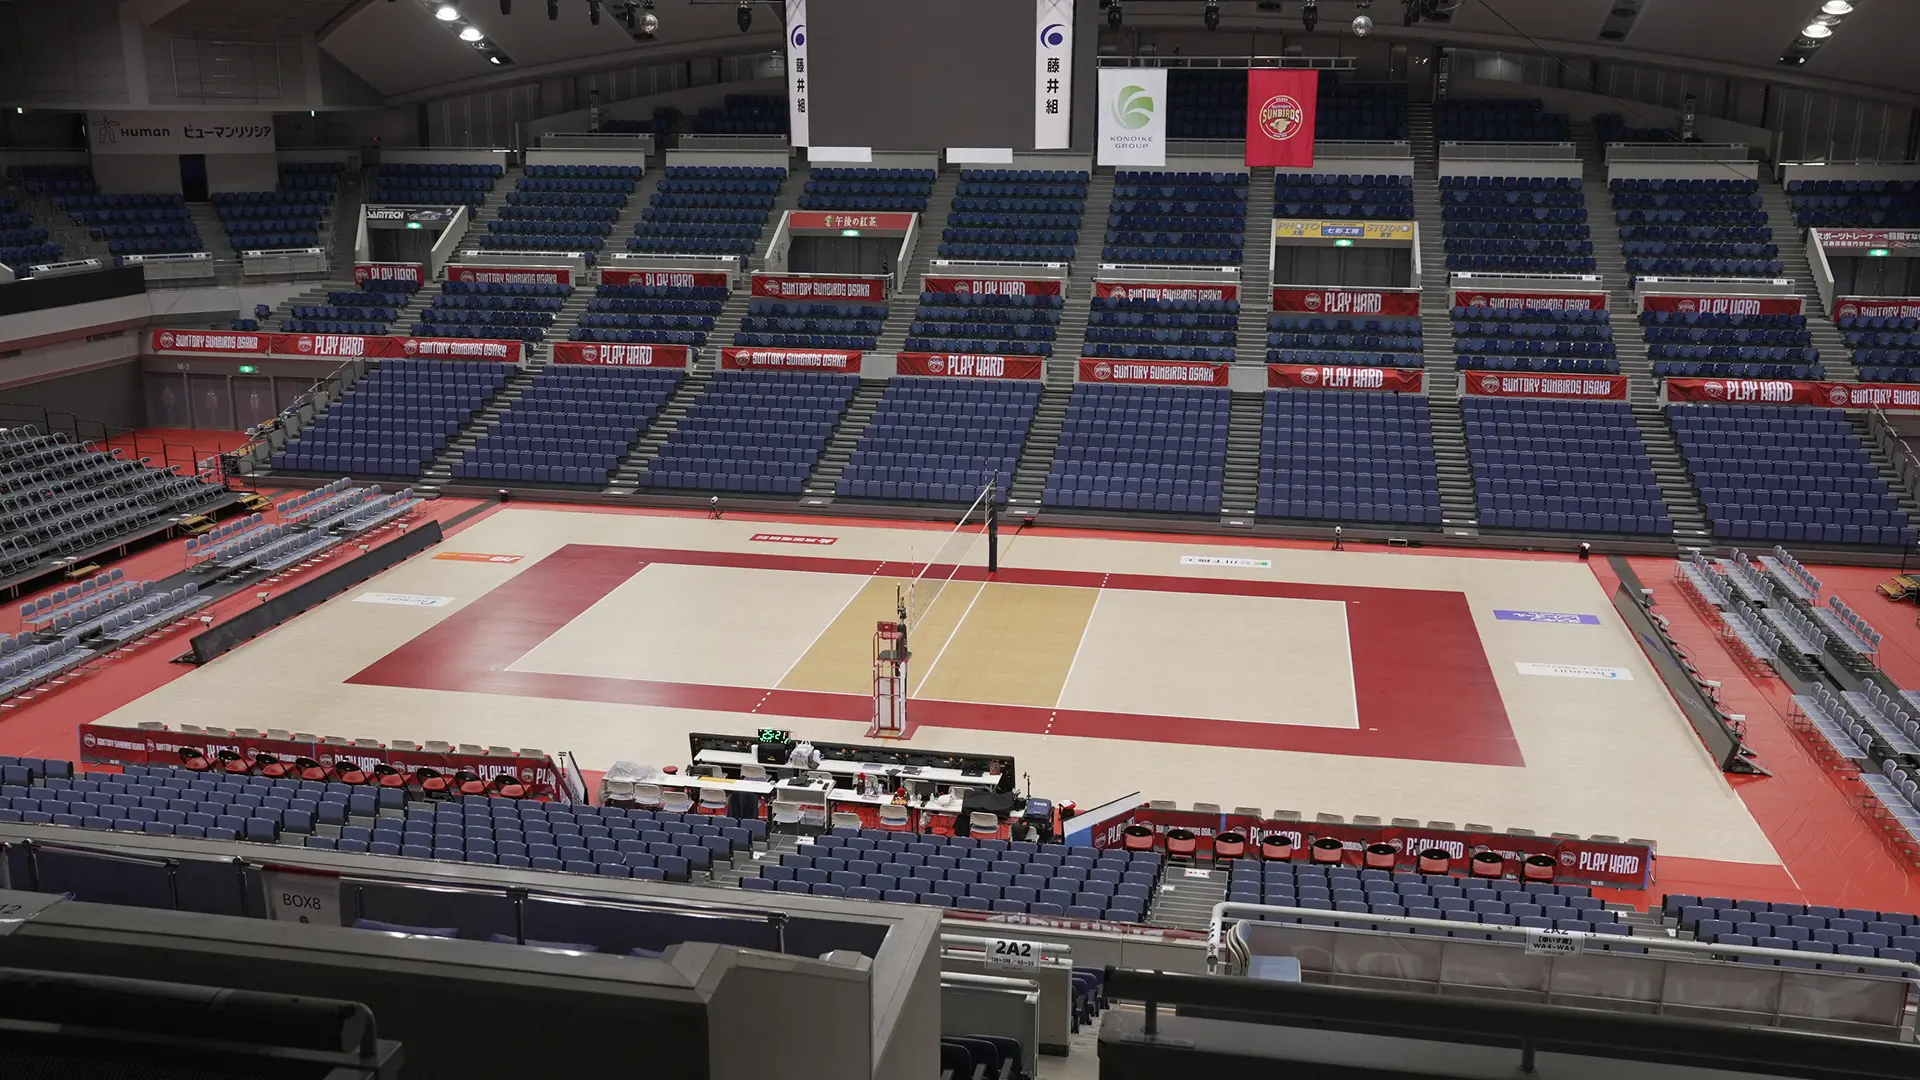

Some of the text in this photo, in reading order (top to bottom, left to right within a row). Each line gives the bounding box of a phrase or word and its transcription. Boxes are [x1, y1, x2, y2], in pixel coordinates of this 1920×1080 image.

[1046, 57, 1060, 114] 藤井組
[1262, 109, 1300, 124] SUNBIRDS
[366, 211, 404, 219] SAMTECH
[835, 215, 877, 228] 午後の紅茶
[1277, 222, 1320, 231] PHOTO
[1366, 224, 1410, 233] STUDIO
[782, 282, 870, 296] SUNTORY SUNBIRDS OSAKA
[1128, 288, 1160, 301] SUNTORY
[1324, 292, 1382, 313] PLAY HARD
[1490, 297, 1590, 310] SUNTORY SUNBIRDS OSAKA
[1861, 306, 1898, 317] SUNTORY
[176, 334, 258, 349] SUNTORY SUNBIRDS OSAKA
[315, 336, 364, 356] PLAY HARD
[419, 342, 507, 357] SUNTORY SUNBIRDS OSAKA
[600, 345, 652, 365] PLAY HARD
[752, 352, 847, 368] SUNTORY SUNBIRDS OSAKA
[948, 356, 1004, 376] PLAY HARD
[1114, 365, 1214, 381] SUNTORY SUNBIRDS OSAKA
[1323, 367, 1383, 388] PLAY HARD
[1502, 378, 1610, 394] SUNTORY SUNBIRDS OSAKA
[1727, 381, 1793, 401] PLAY HARD
[1851, 389, 1891, 404] SUNTORY
[1579, 851, 1639, 874] PLAY HARD
[282, 893, 321, 911] BOX8
[996, 941, 1031, 957] 2A2
